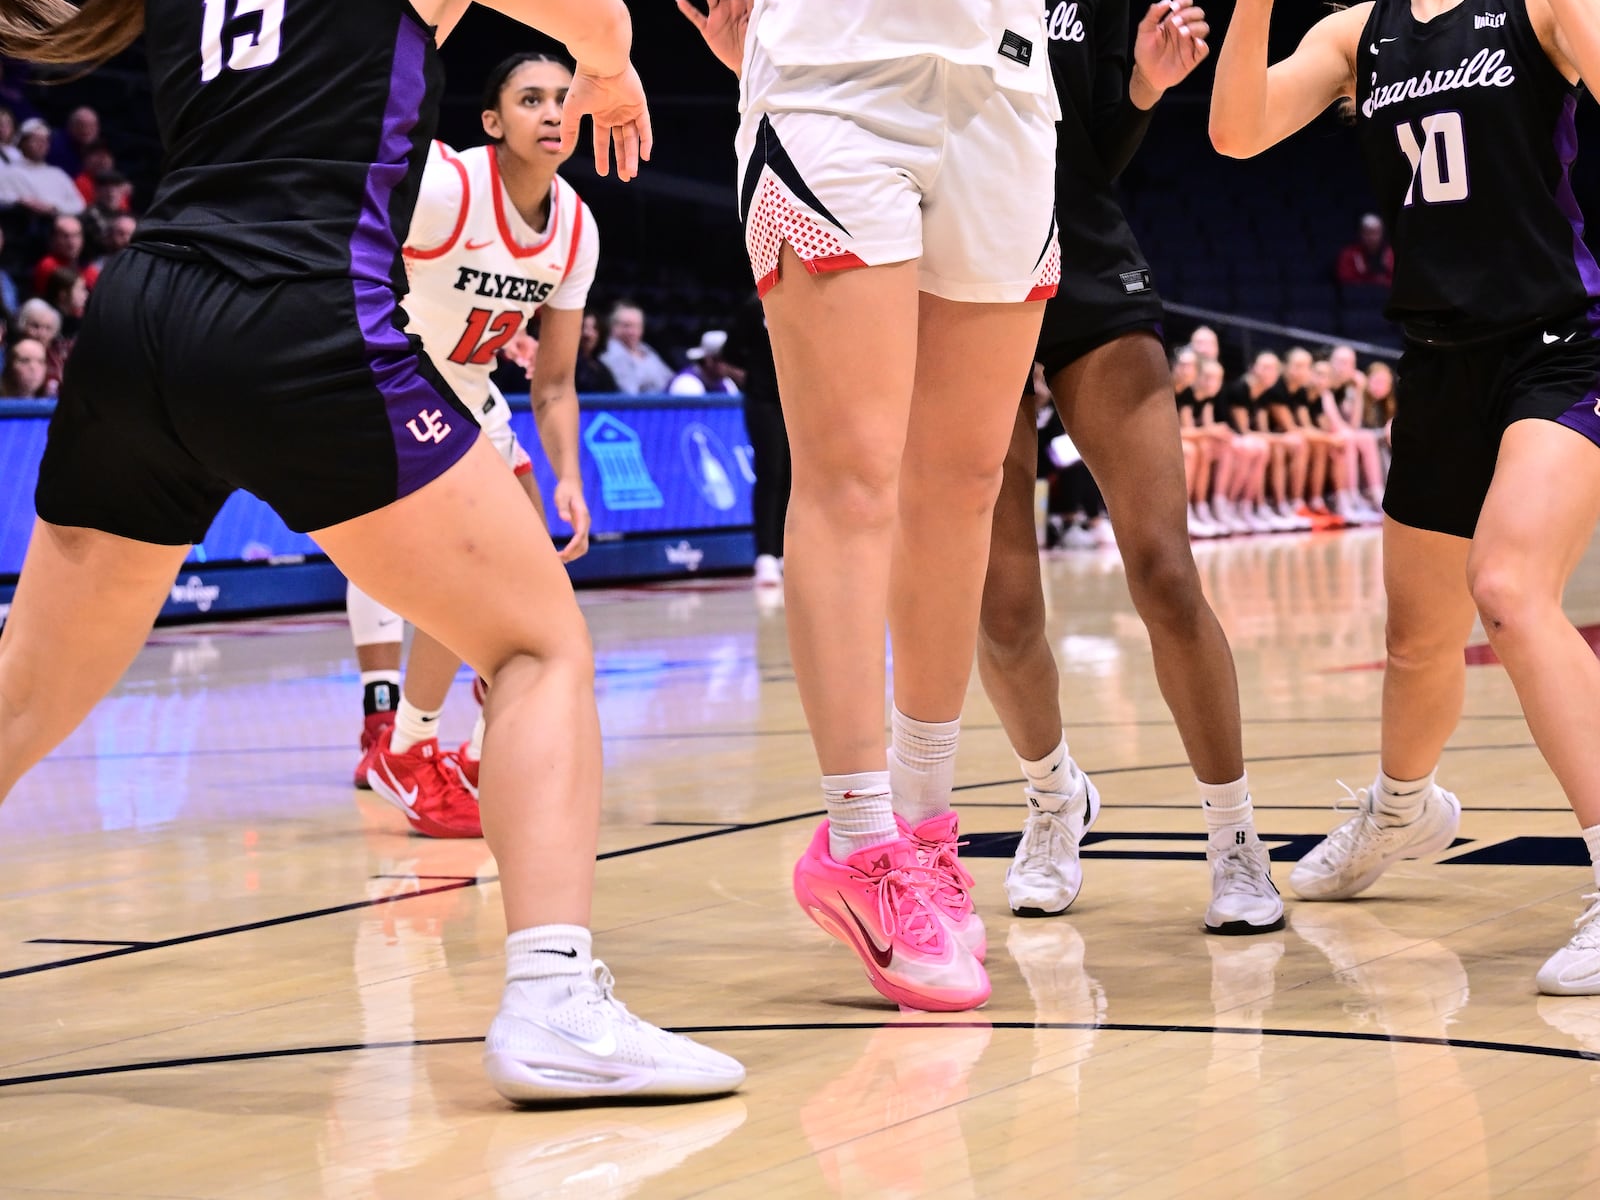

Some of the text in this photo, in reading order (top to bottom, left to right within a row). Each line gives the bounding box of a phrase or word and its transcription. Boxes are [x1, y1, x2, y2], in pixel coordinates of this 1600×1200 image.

[1474, 12, 1507, 30] VALLEY
[1395, 109, 1470, 208] 10
[453, 266, 554, 302] FLYERS
[447, 307, 524, 365] 12
